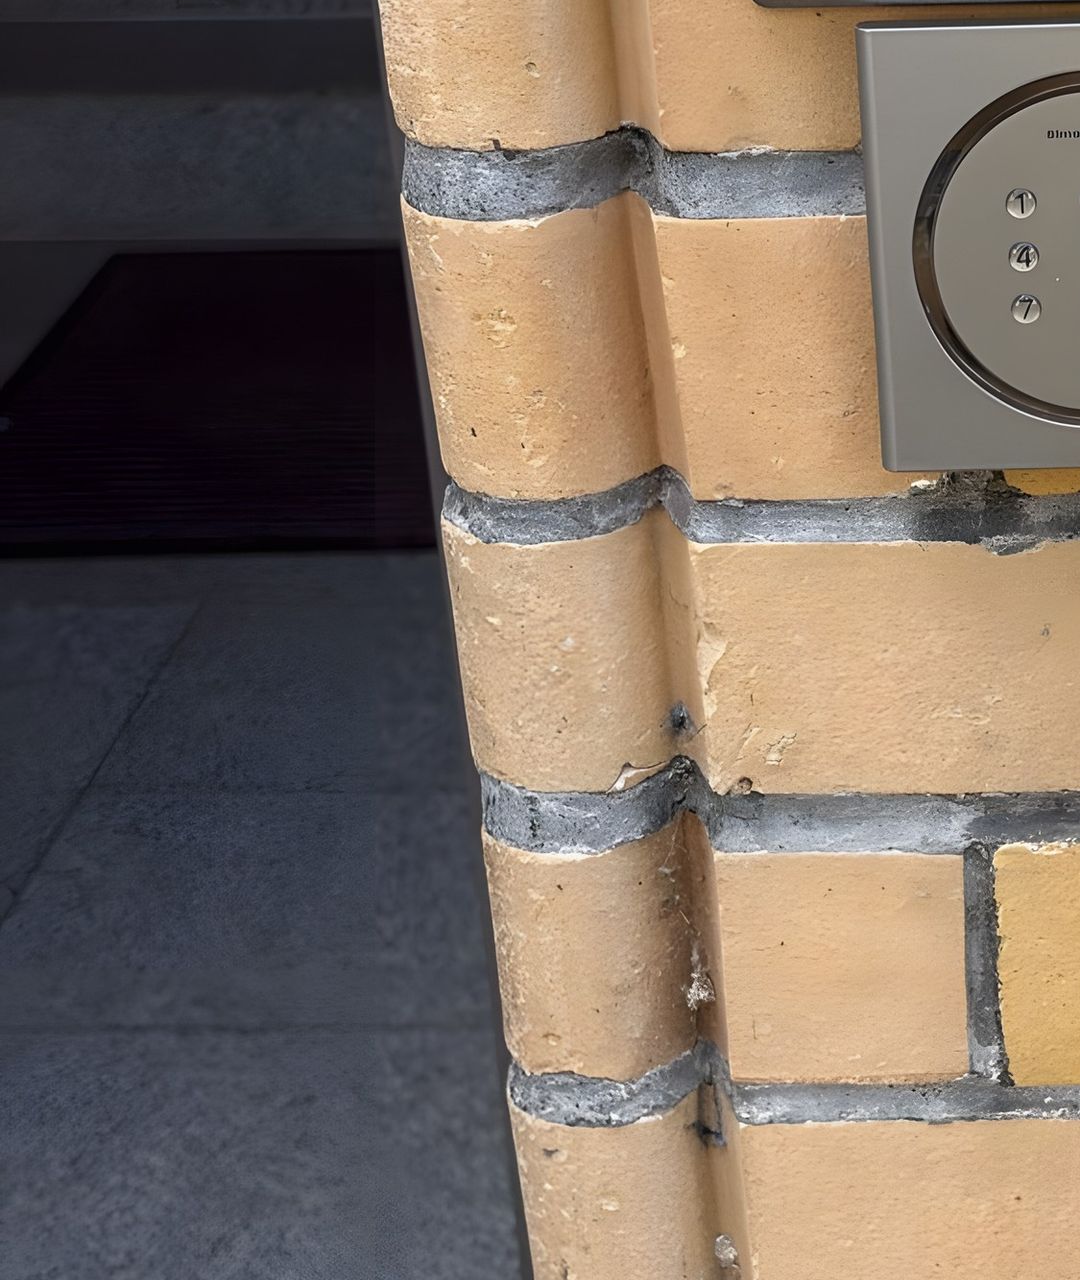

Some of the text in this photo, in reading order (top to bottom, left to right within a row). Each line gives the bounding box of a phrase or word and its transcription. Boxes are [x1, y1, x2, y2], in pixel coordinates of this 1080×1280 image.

[1014, 191, 1026, 215] 1
[1016, 245, 1032, 268] 4
[1018, 298, 1034, 320] 7
